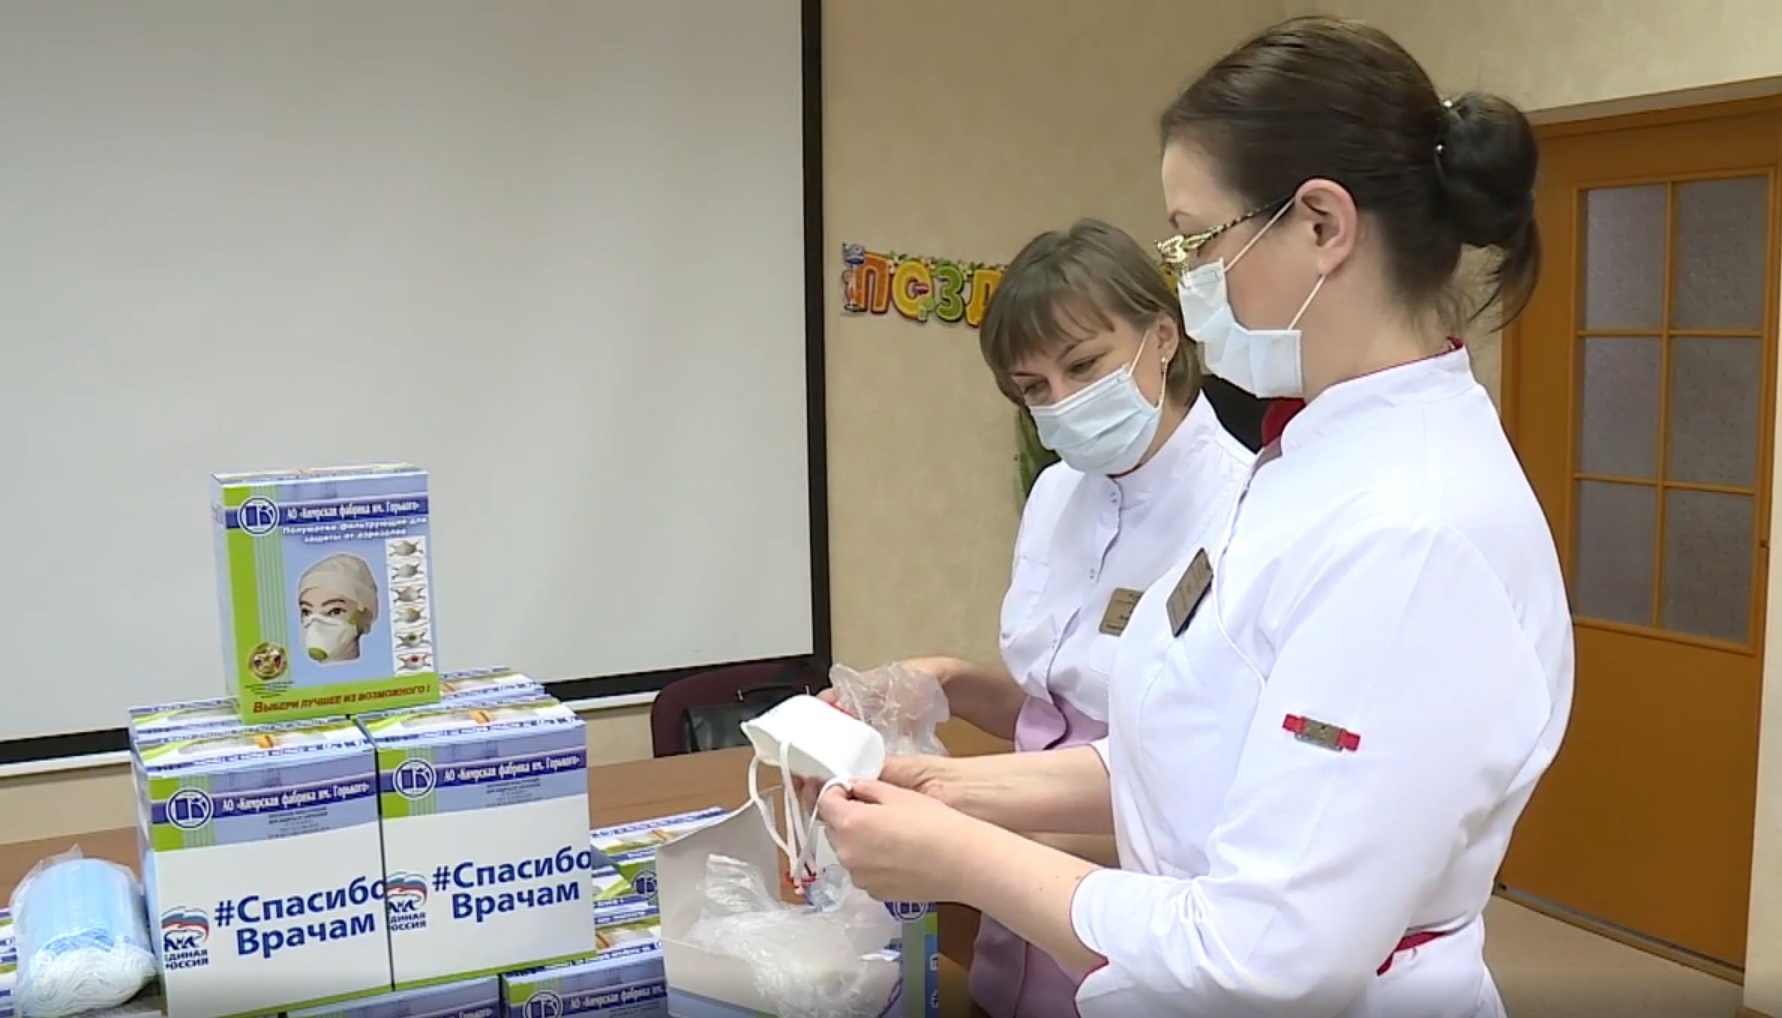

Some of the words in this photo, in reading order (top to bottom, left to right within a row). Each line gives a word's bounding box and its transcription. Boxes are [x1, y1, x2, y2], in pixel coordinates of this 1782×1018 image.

[281, 789, 316, 809] фабрика
[432, 845, 592, 892] #Спасибо
[214, 875, 386, 928] #Спасибо
[388, 912, 426, 923] ДИНАЯ
[452, 881, 580, 923] Врачам
[235, 912, 376, 959] Врачам
[388, 920, 427, 931] ОССИЯ
